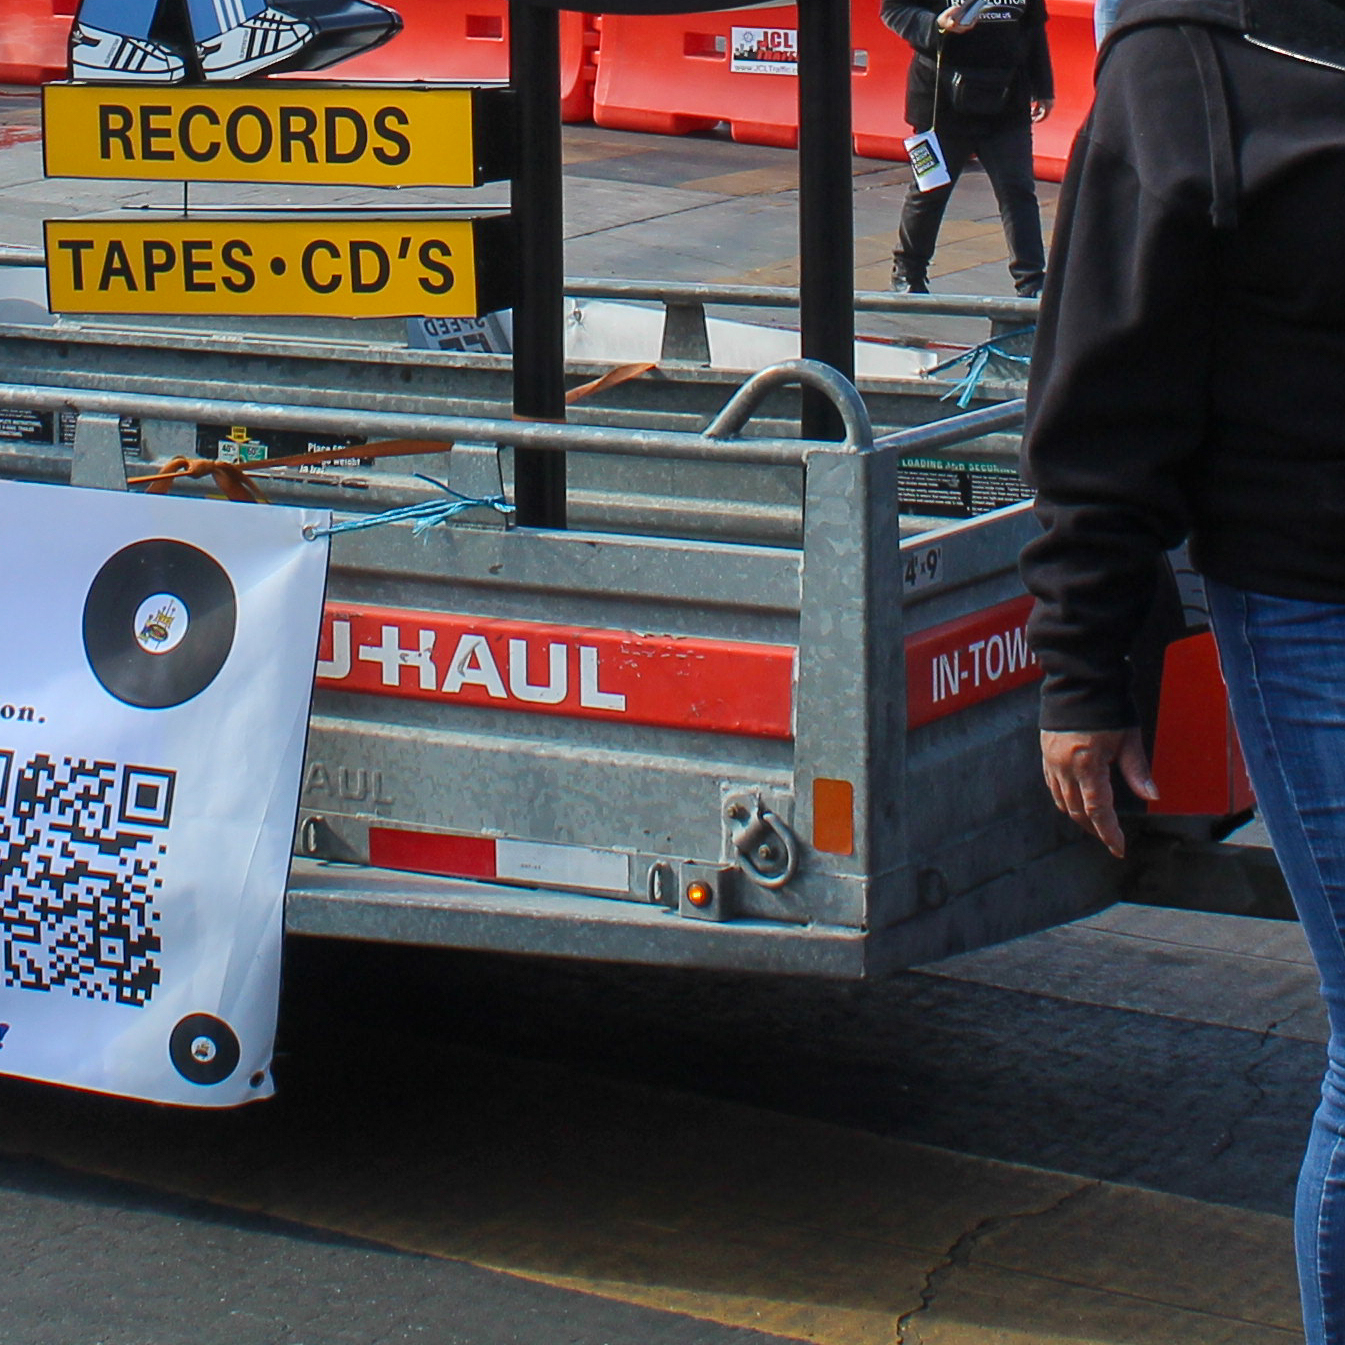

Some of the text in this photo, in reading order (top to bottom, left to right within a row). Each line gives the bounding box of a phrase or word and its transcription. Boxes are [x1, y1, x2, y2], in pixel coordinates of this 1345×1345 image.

[757, 30, 794, 49] JCL
[98, 103, 412, 166] RECORDS
[58, 238, 455, 295] TAPES CD'S
